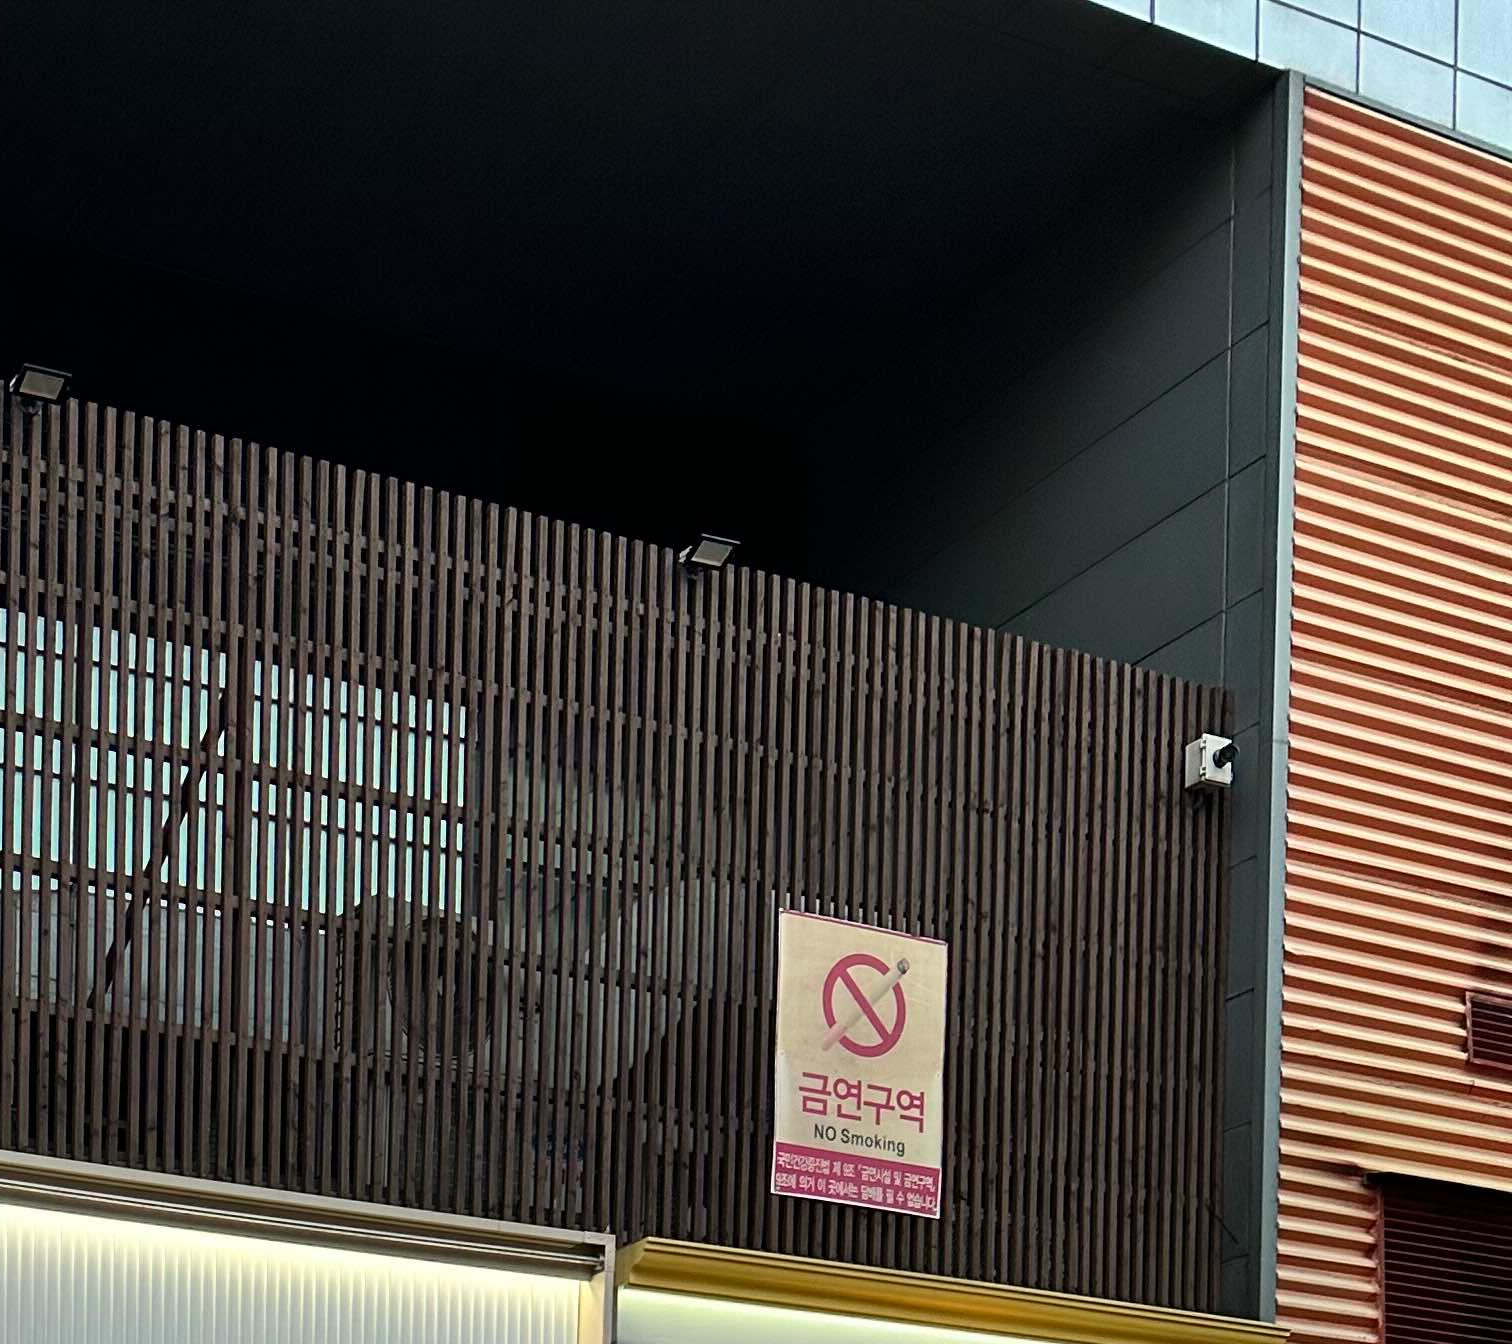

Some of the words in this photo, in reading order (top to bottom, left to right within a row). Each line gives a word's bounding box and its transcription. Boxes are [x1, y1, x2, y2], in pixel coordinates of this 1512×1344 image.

[798, 1072, 925, 1133] 금연구역
[814, 1123, 836, 1142] NO
[841, 1128, 905, 1157] Smoking
[817, 1178, 826, 1193] 이
